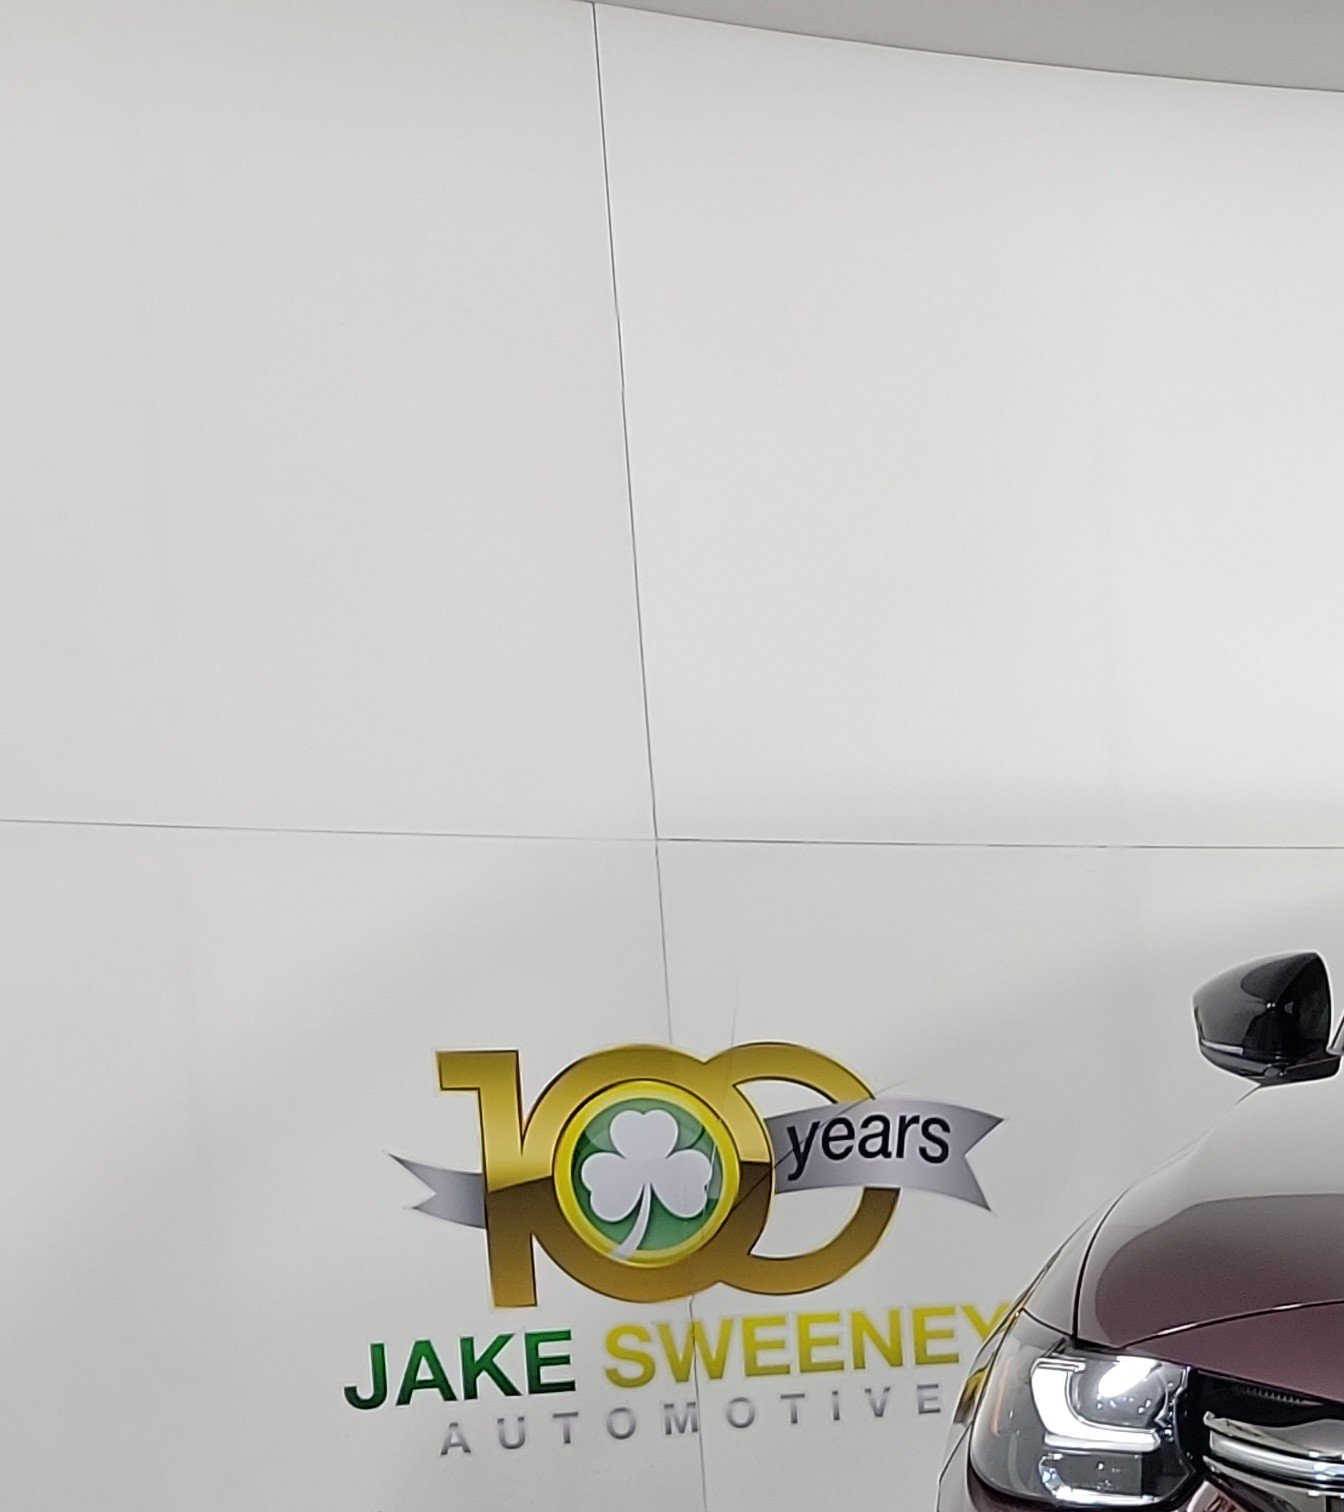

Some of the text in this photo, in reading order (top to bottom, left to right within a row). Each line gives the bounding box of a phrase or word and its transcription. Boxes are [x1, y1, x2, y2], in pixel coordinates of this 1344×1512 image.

[435, 1041, 951, 1308] 100 years
[343, 1302, 1013, 1411] JAKE SWEENEY
[440, 1382, 942, 1457] AUTOMOTIVE
